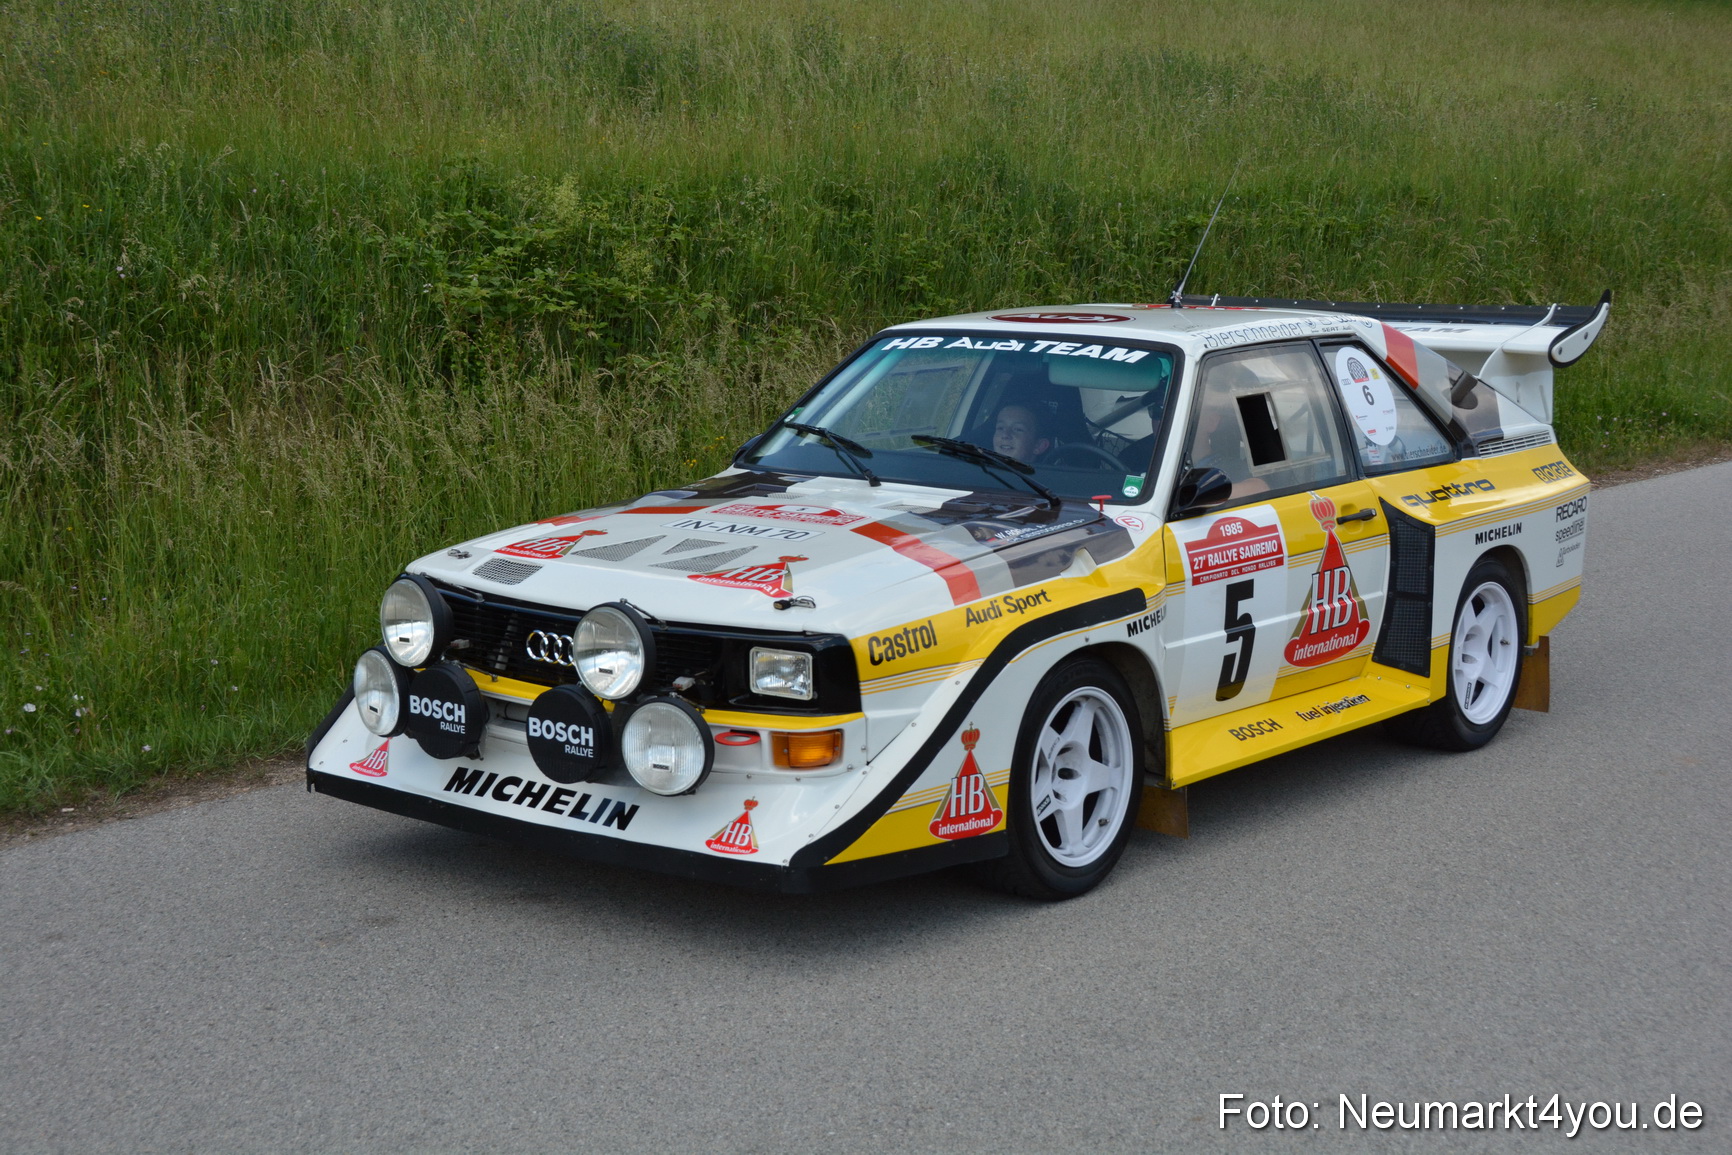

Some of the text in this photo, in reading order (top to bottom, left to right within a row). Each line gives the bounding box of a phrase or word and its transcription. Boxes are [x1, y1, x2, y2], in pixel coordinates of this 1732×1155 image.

[882, 336, 1150, 364] HB Audi TEAM
[1362, 385, 1375, 406] 6
[1401, 479, 1496, 509] quattro
[1556, 496, 1587, 522] RECARO
[673, 519, 809, 540] IN-NM 70
[1220, 522, 1243, 536] 1985
[1475, 522, 1522, 545] MICHELIN
[513, 538, 575, 552] HB
[1208, 548, 1238, 566] RALLYE
[1239, 540, 1278, 559] SANREMO
[720, 565, 789, 582] HB
[1200, 571, 1228, 583] CAMPIONATO
[1242, 565, 1257, 573] MONDO
[1258, 560, 1276, 569] RALLYES
[697, 576, 780, 595] international
[966, 589, 1052, 627] Audi Sport
[1310, 566, 1352, 635] HB
[867, 620, 938, 666] Castrol
[1215, 578, 1256, 702] 5
[1293, 627, 1359, 662] international
[409, 695, 465, 724] BOSCH
[1228, 694, 1371, 741] BOSCH fuel injection
[440, 721, 465, 734] RALLYE
[528, 716, 594, 747] BOSCH
[363, 750, 388, 770] HB
[565, 744, 594, 758] RALLYE
[443, 767, 640, 831] MICHELIN
[950, 773, 985, 818] HB
[720, 821, 753, 847] HB
[938, 813, 994, 836] international
[710, 842, 752, 854] international
